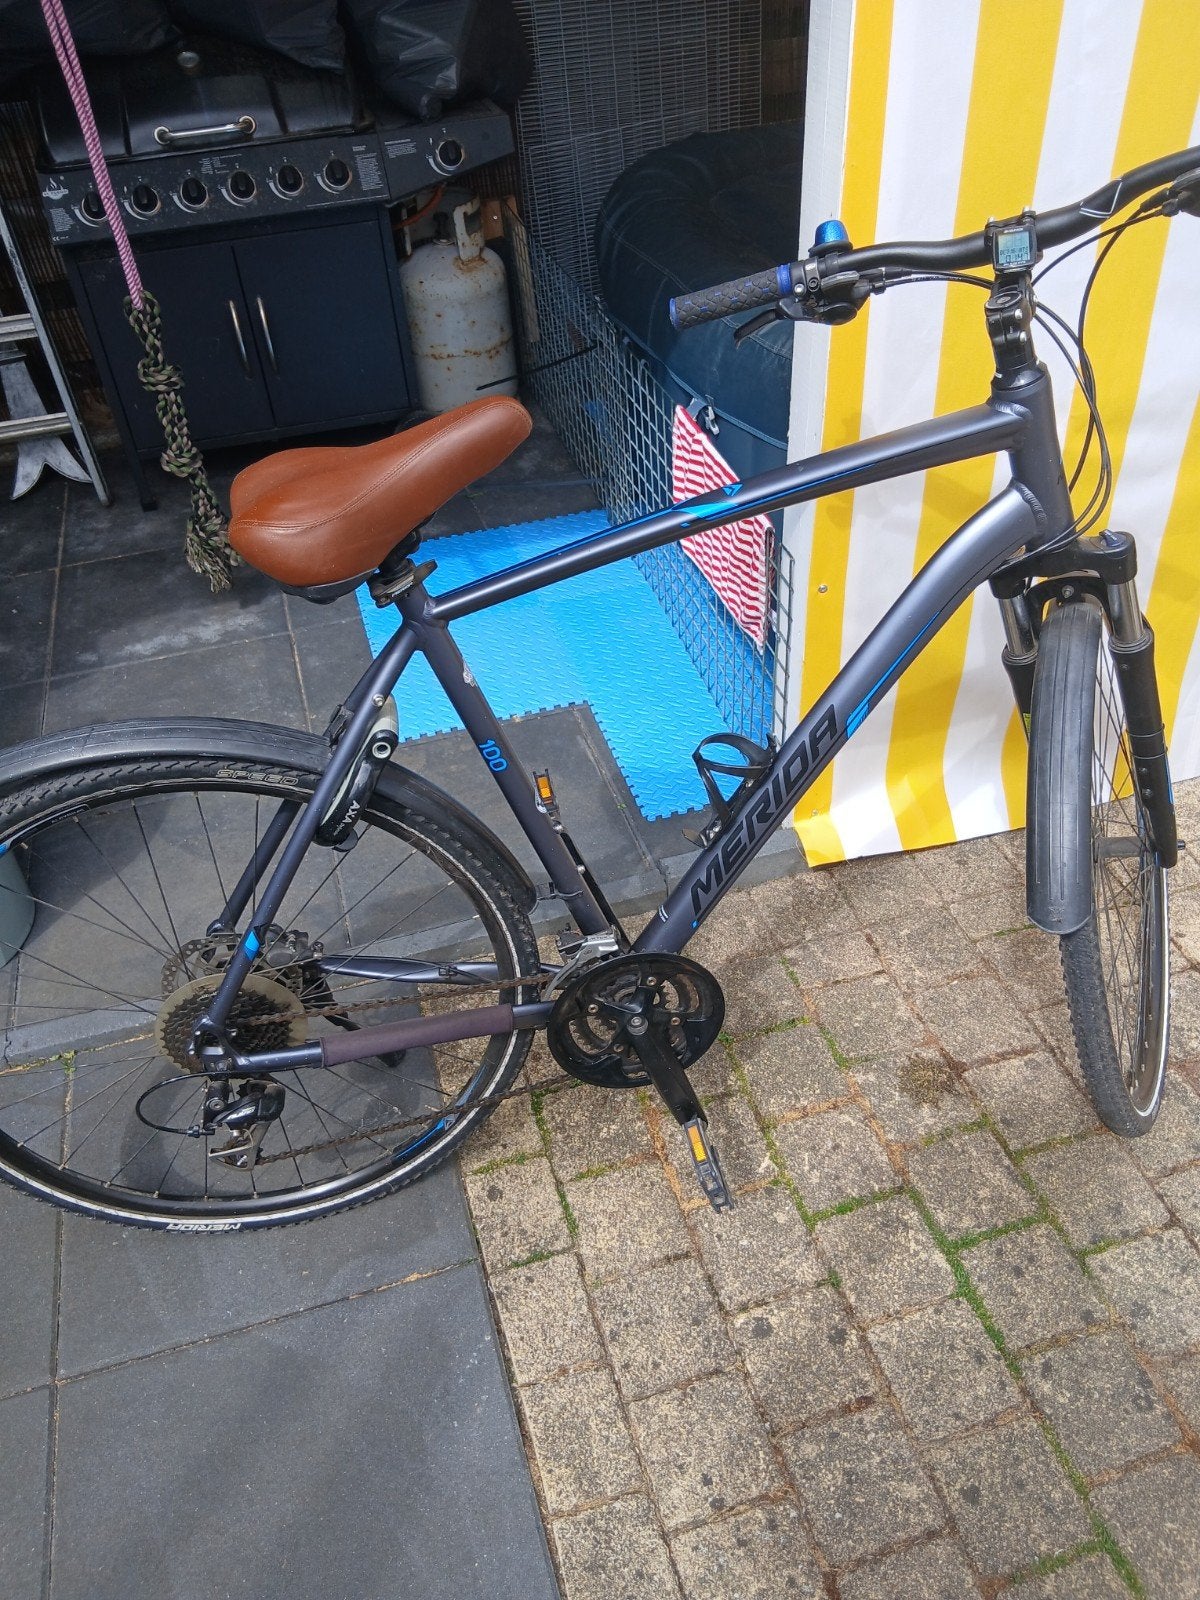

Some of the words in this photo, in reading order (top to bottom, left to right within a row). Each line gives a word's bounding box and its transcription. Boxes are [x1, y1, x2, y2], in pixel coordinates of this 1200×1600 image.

[479, 739, 507, 771] 100
[216, 769, 299, 786] SPEED
[342, 800, 361, 823] AXA
[690, 704, 838, 915] MERIDA
[166, 1223, 241, 1231] MERIDA
